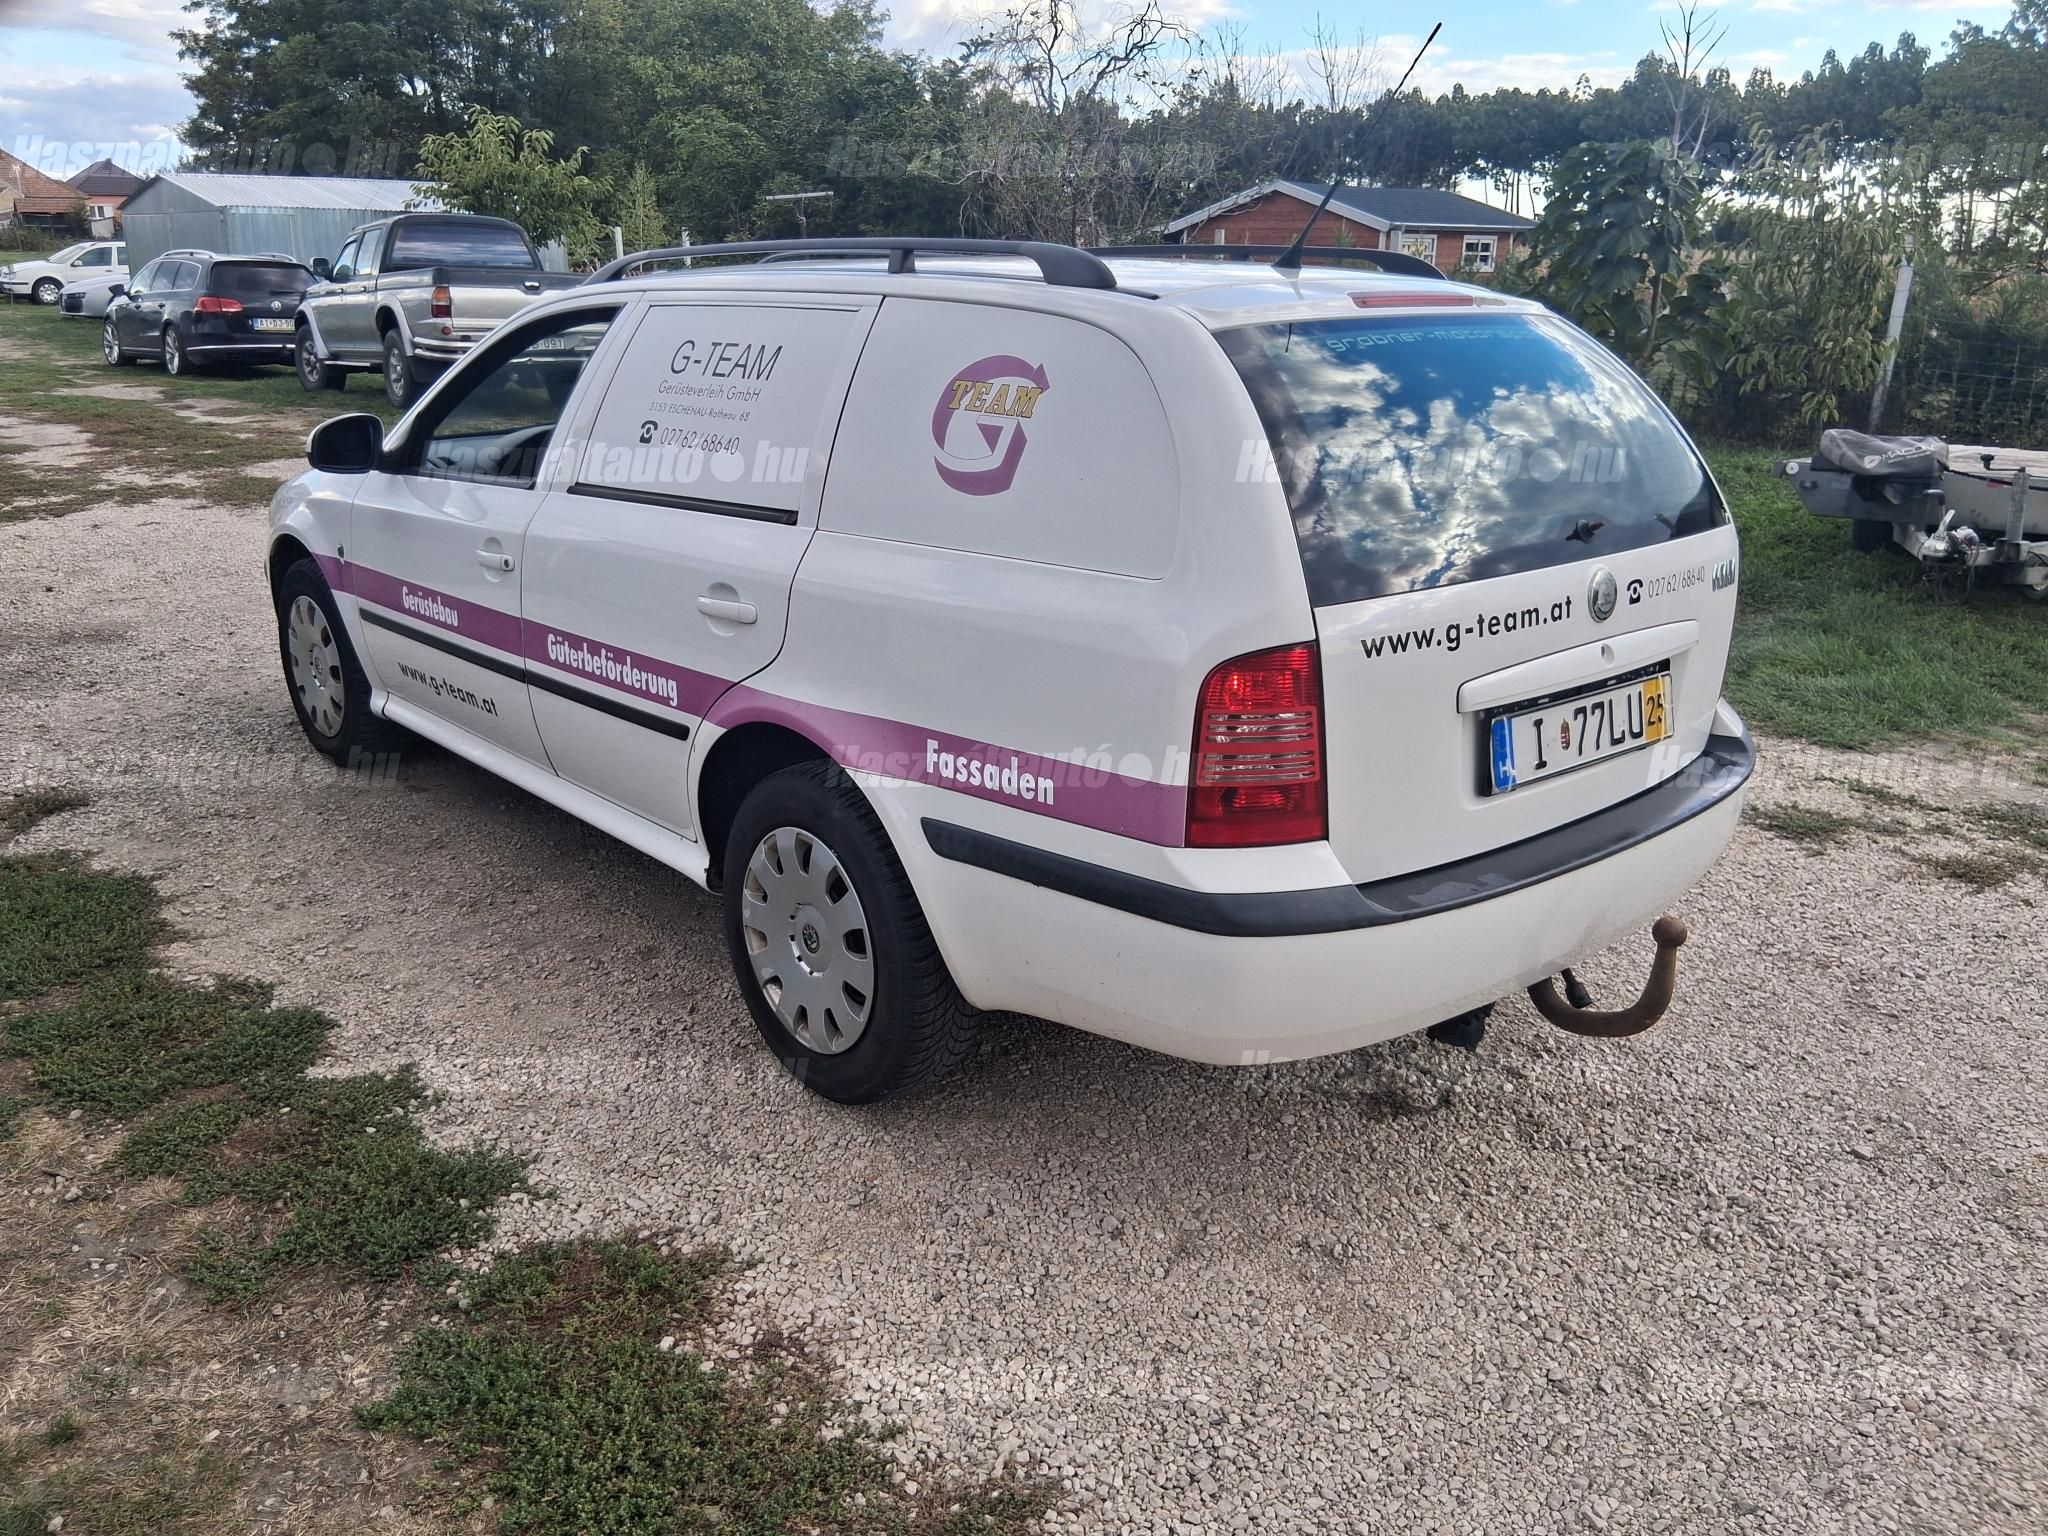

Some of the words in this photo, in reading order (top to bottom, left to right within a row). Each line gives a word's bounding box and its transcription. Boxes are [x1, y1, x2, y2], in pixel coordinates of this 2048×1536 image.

[670, 339, 783, 381] G-TEAM
[649, 401, 668, 413] 3153
[739, 411, 751, 422] 68
[658, 380, 725, 399] Gerüsteverleih
[726, 385, 762, 402] GmbH
[948, 379, 1044, 419] TEAM
[660, 427, 740, 455] 02762/68640
[1648, 566, 1706, 598] 02762/68640
[401, 586, 459, 628] Gerüstebau
[1361, 596, 1573, 659] www.g-team.at
[398, 661, 499, 718] www.g-team.at
[546, 633, 678, 707] Güterbeförderung
[925, 738, 1055, 806] Fassaden
